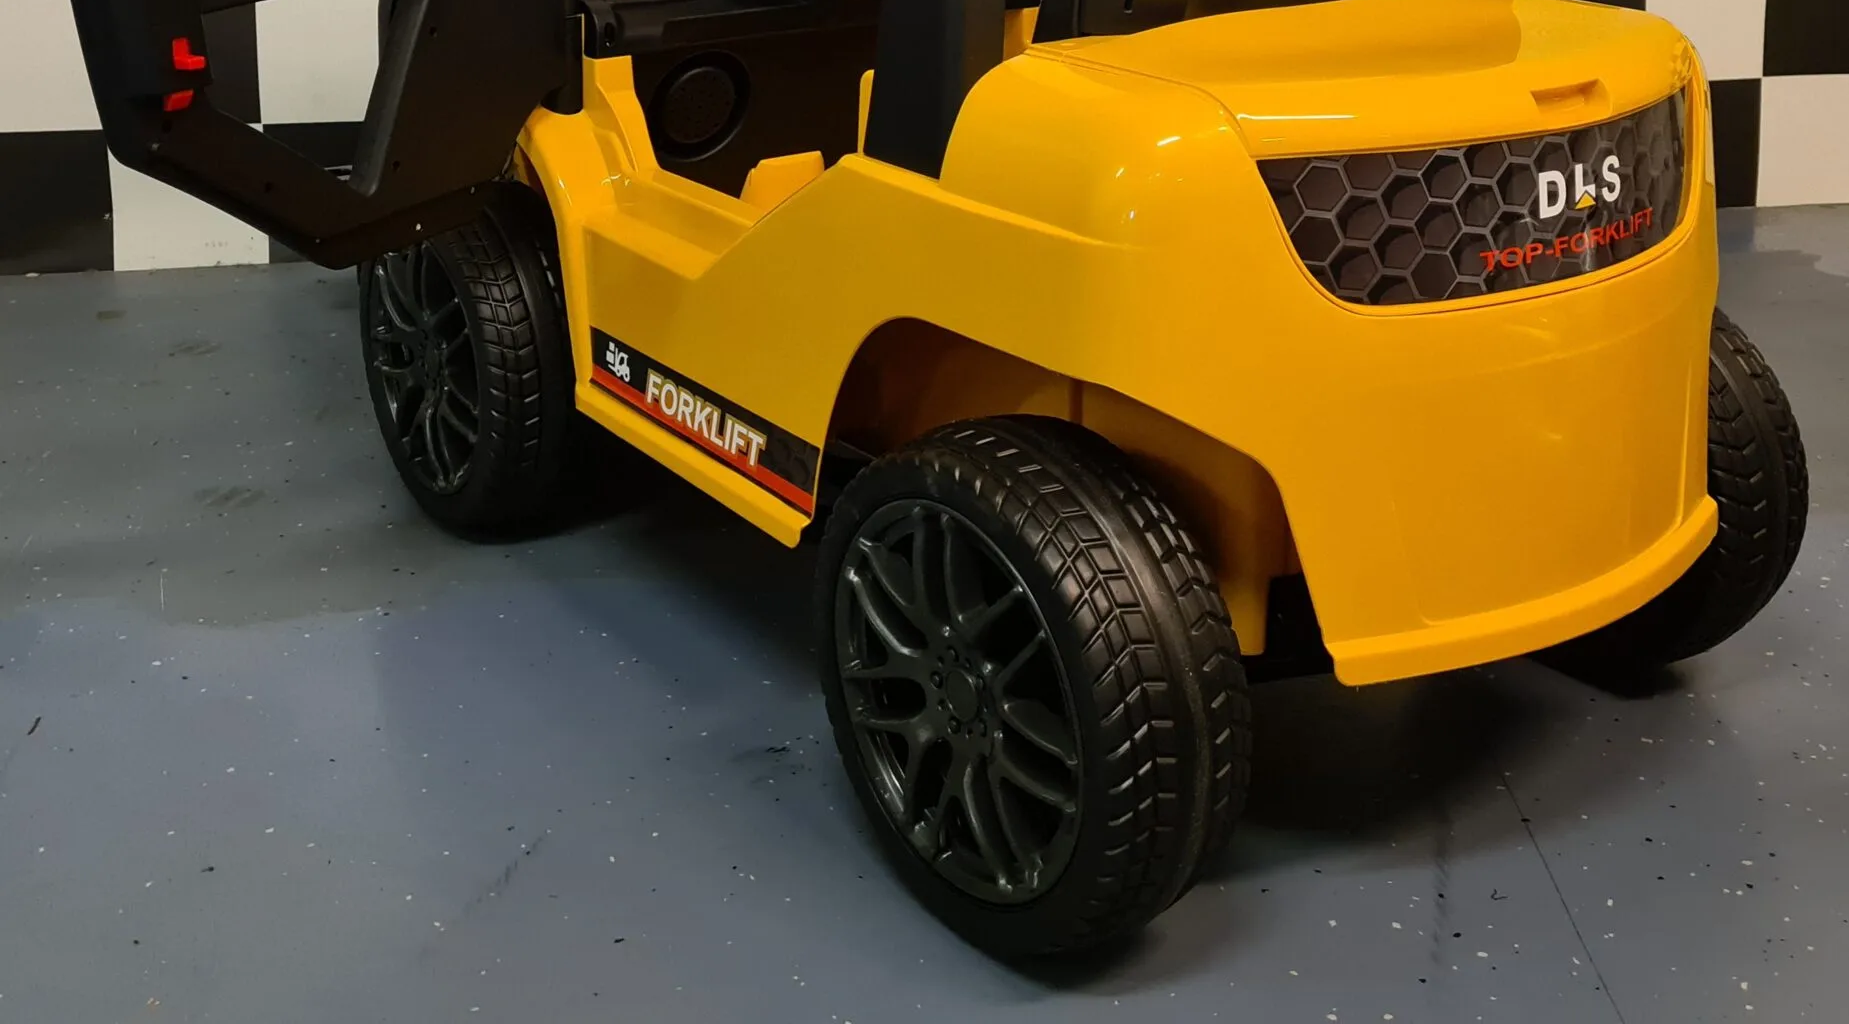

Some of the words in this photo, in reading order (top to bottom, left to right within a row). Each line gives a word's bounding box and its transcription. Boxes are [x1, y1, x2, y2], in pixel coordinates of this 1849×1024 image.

[1538, 154, 1621, 219] DLS
[1479, 207, 1653, 272] TOP-FORKLIFT
[646, 370, 766, 467] FORKLIFT
